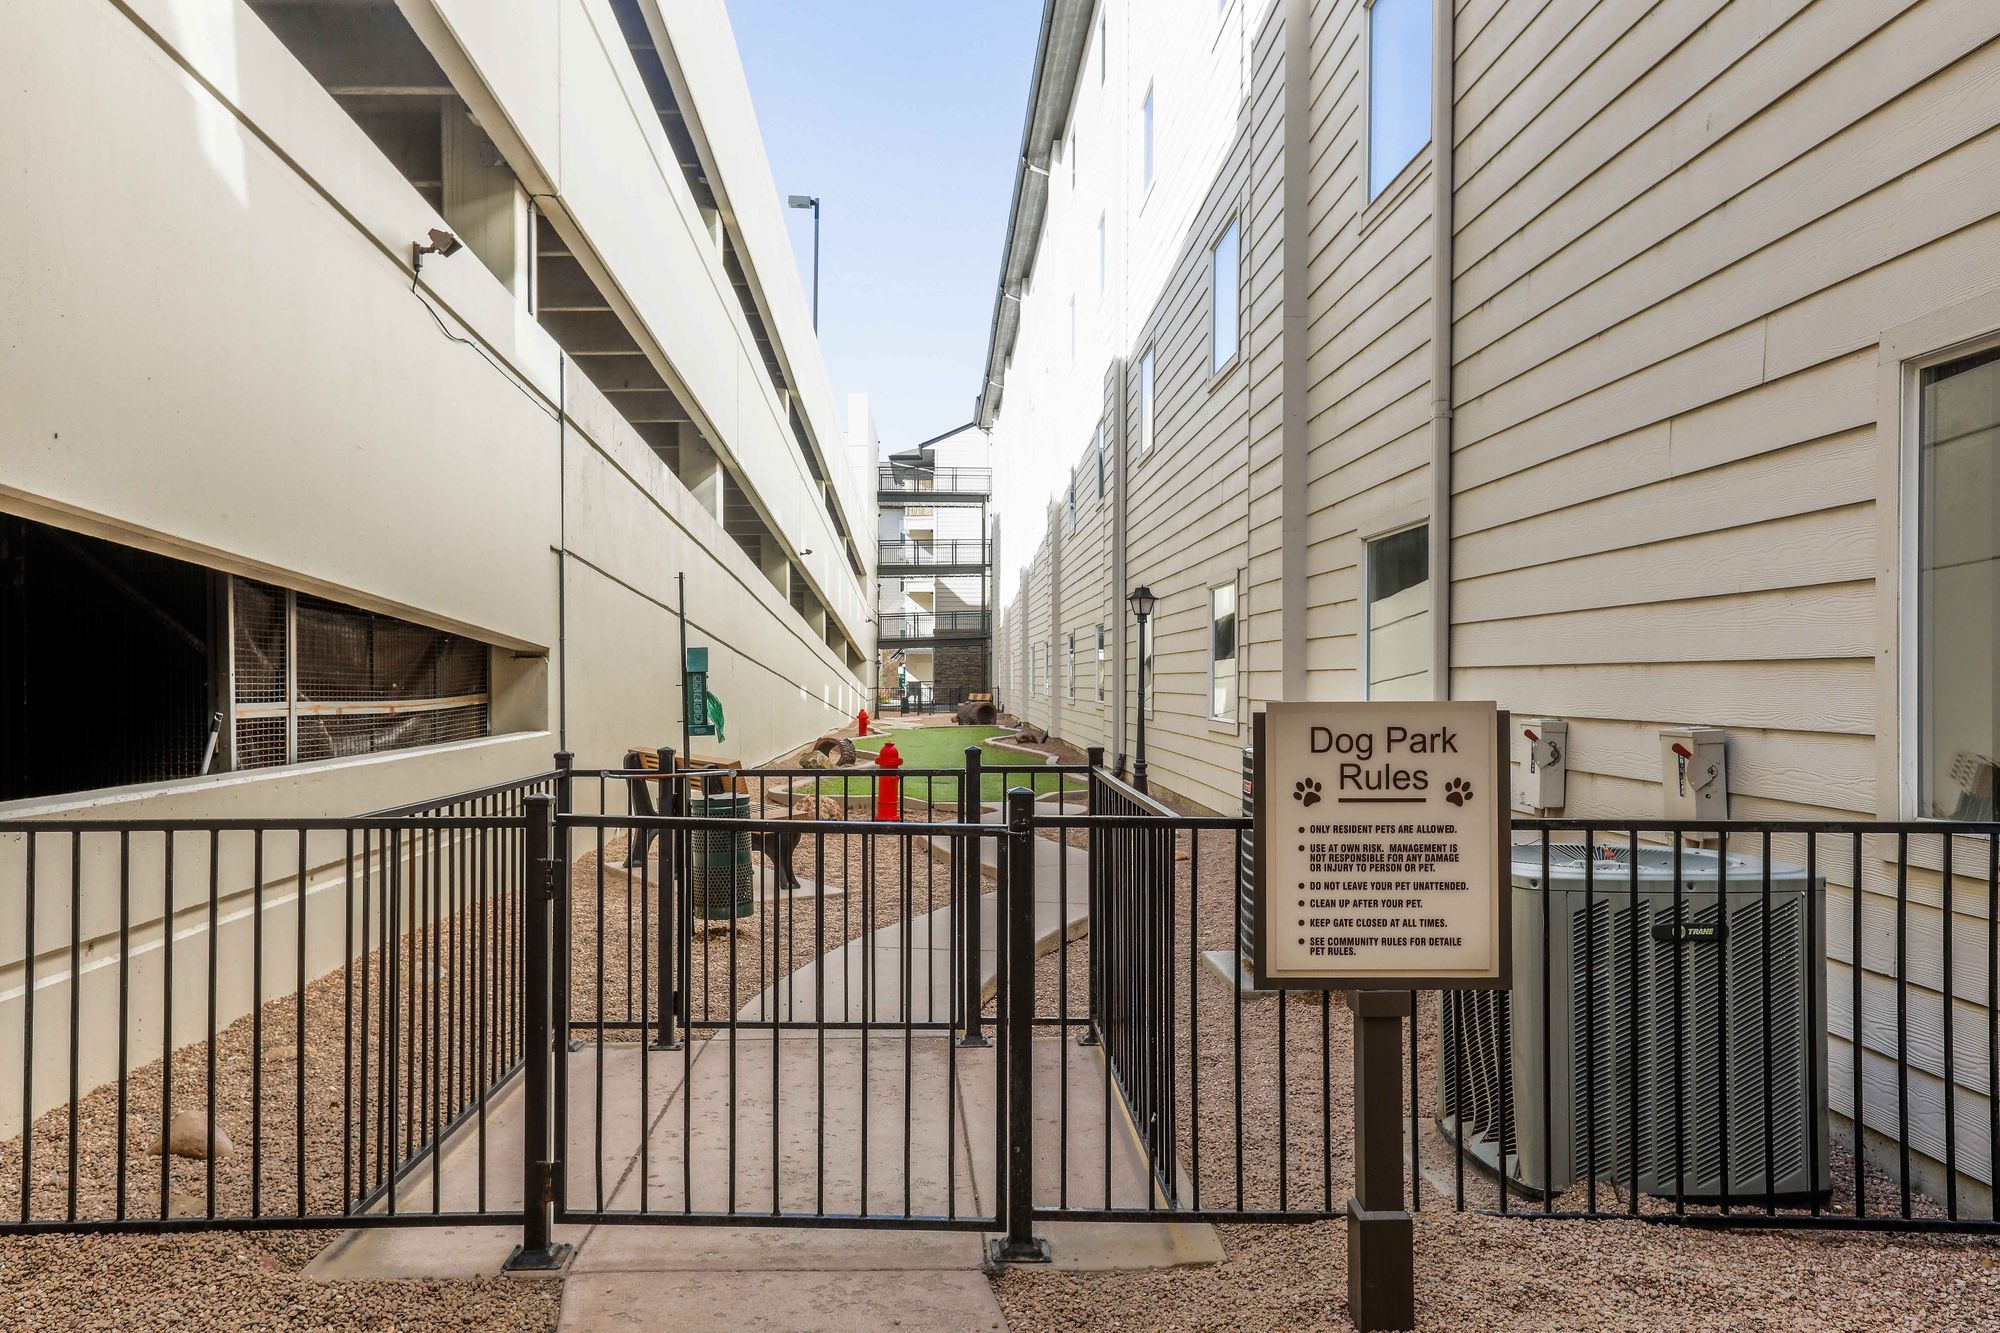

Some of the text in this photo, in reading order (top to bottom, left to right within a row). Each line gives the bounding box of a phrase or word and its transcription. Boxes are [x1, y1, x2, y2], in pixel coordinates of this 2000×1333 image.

[1309, 726, 1459, 760] Dog Park
[1339, 762, 1429, 791] Rules
[1310, 824, 1457, 834] ONLY RESIDENT PETS ARE ALLOWED.
[1309, 843, 1458, 853] USE AT OWN RISK. MANAGEMENT IS
[1309, 853, 1460, 863] NOT RESPONSIBLE FOR ANY DAMAGE
[1309, 863, 1436, 873] OR INJURY TO PERSON OR PET.
[1309, 881, 1469, 891] DO NOT LEAVE YOUR PET UNATTENDED.
[1309, 899, 1423, 908] CLEAN UP AFTER YOUR PET.
[1310, 918, 1448, 928] KEEP GATE CLOSED AT ALL TIMES.
[1309, 937, 1462, 947] SEE COMMUNITY RULES FOR DETAILE
[1309, 946, 1356, 956] PET RULES.
